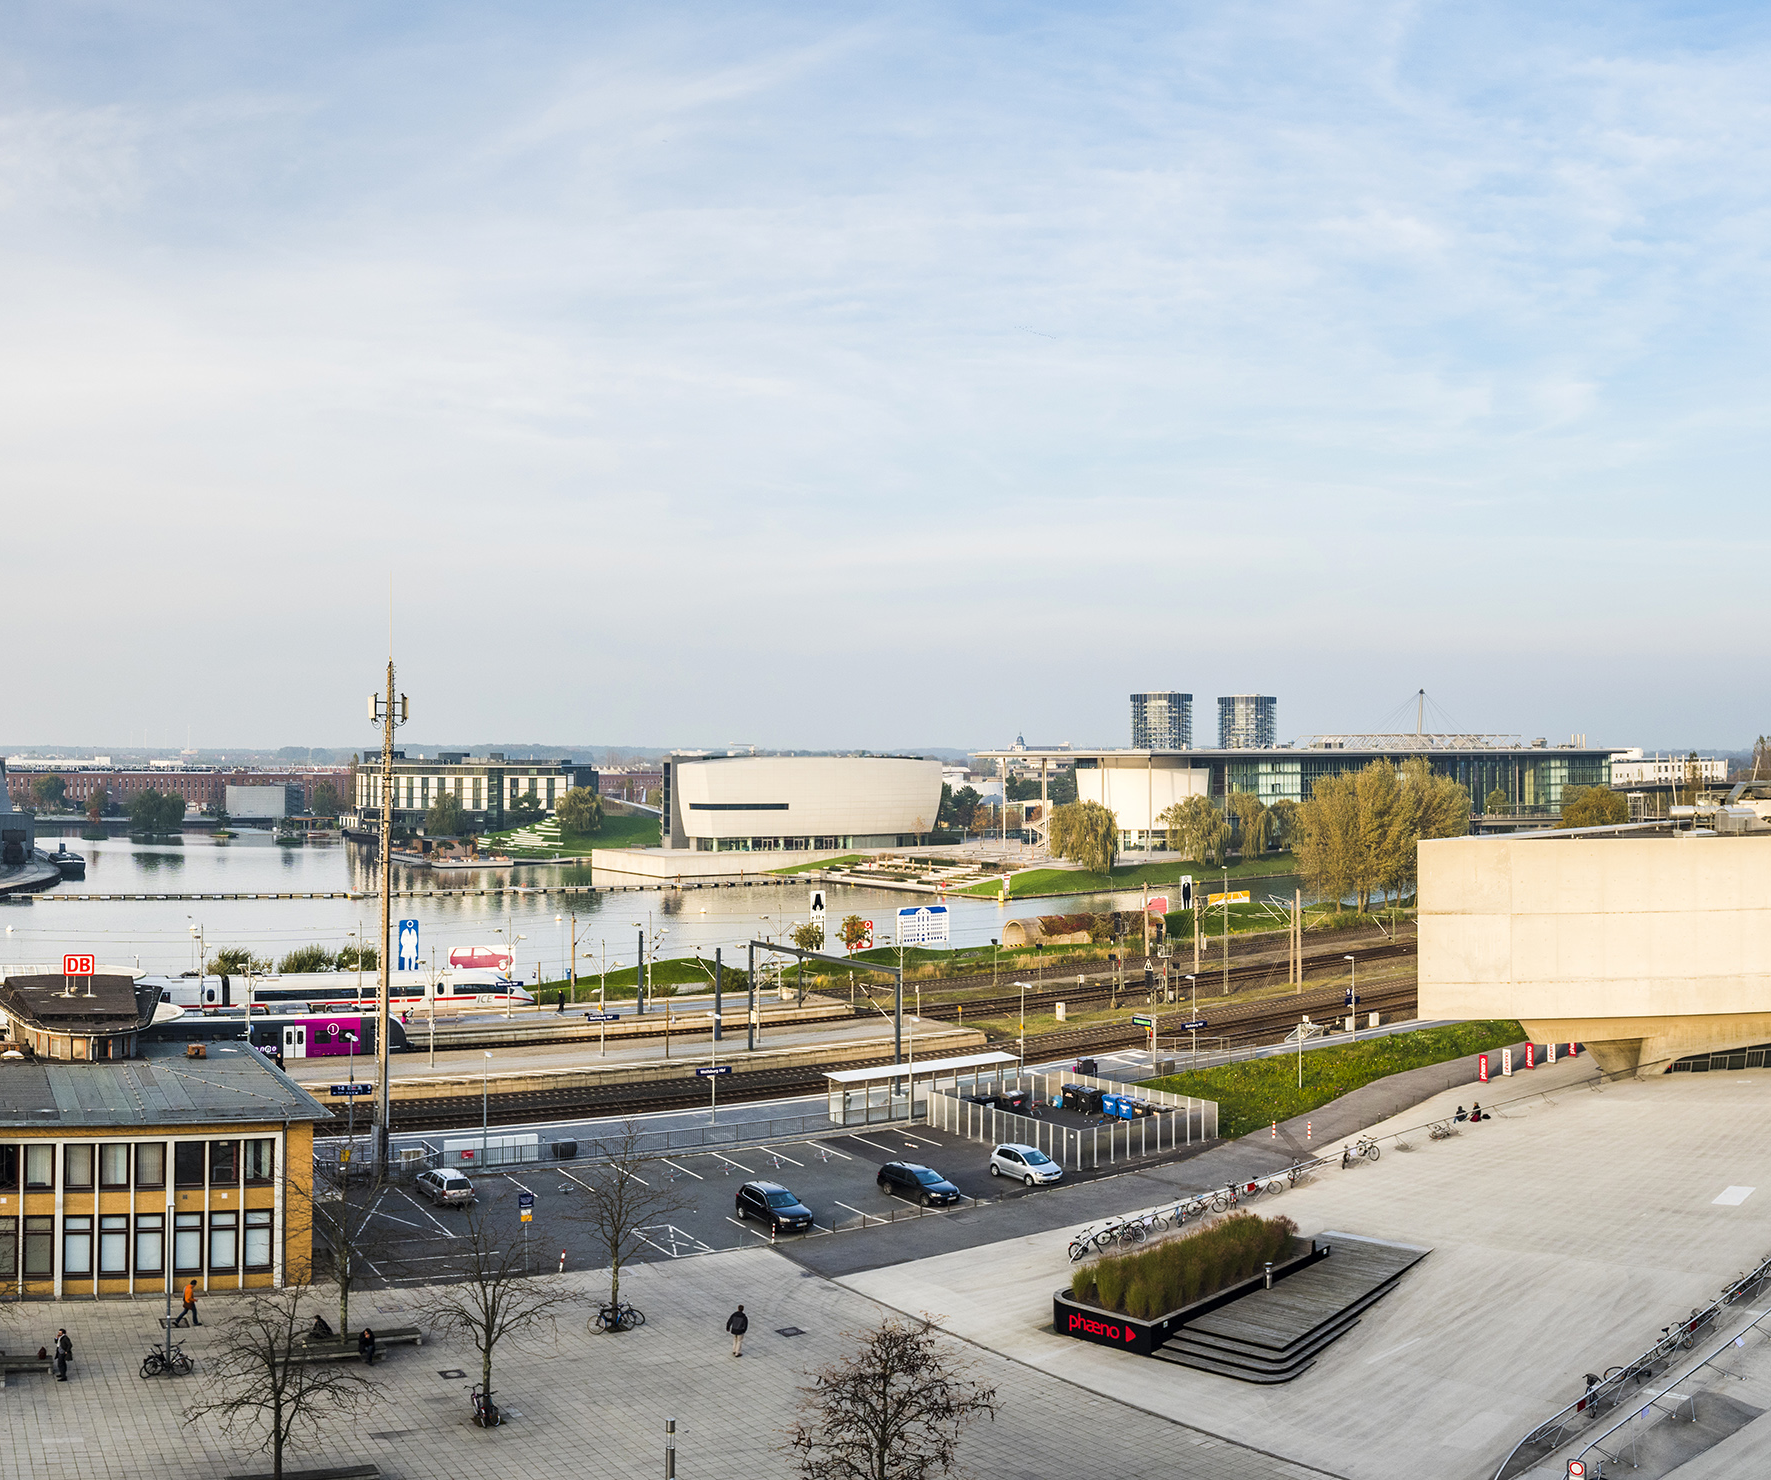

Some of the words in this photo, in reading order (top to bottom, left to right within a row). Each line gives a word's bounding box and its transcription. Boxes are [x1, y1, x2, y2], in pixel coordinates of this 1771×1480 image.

[67, 957, 91, 972] DB
[477, 994, 493, 1003] ICE
[1069, 1312, 1120, 1340] phæno
